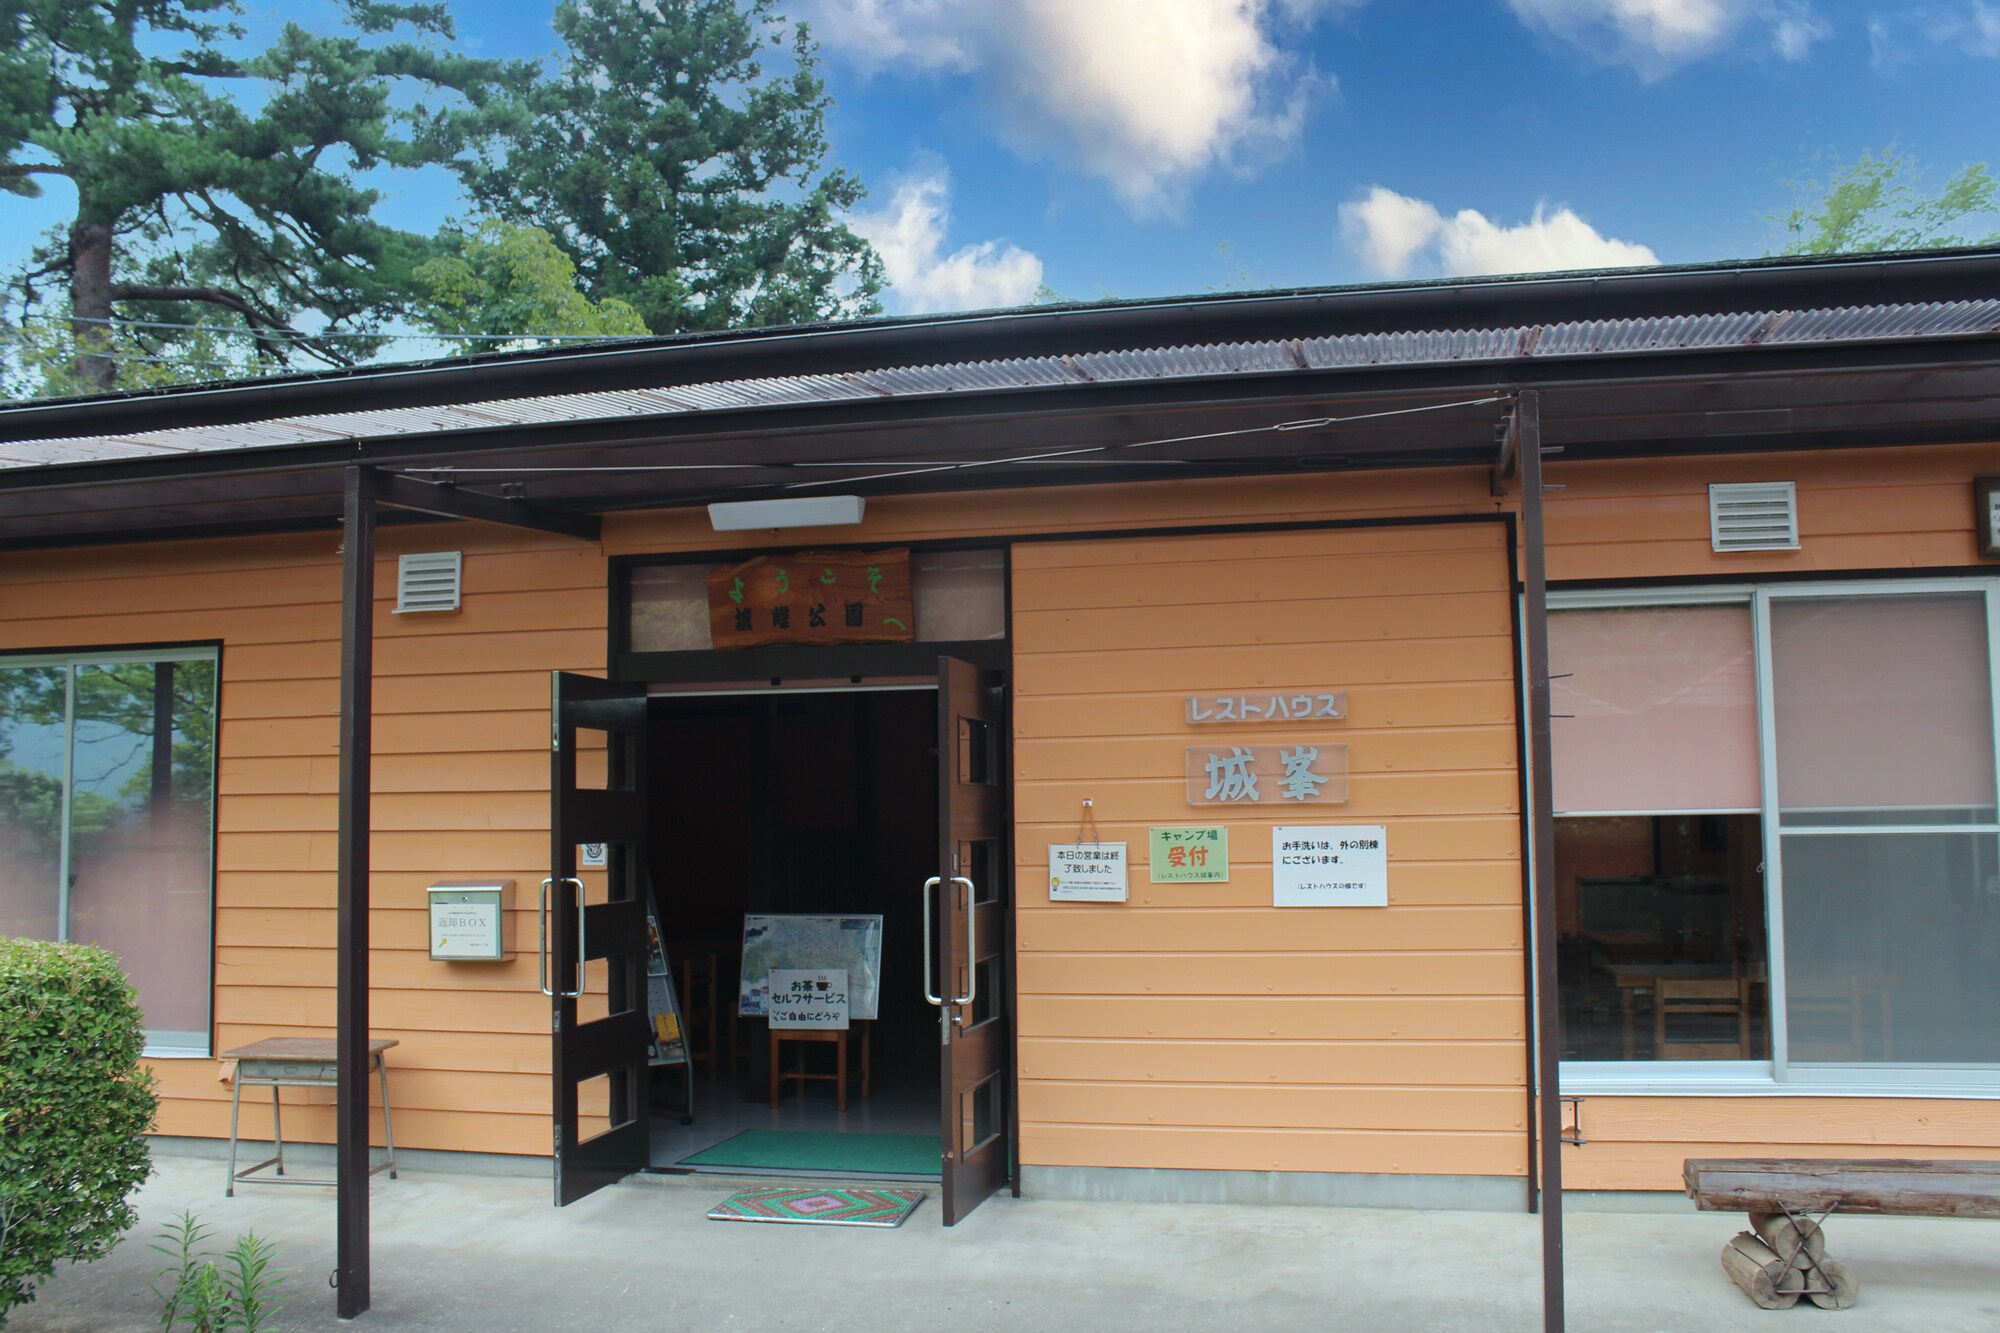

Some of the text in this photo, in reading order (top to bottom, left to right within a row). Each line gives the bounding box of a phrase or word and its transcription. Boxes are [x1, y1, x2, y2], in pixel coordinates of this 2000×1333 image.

[1192, 694, 1339, 721] レストハウス
[1161, 830, 1218, 841] キャンプ場
[1057, 850, 1119, 860] 本日の営業は終
[1168, 845, 1208, 868] 受付
[1064, 864, 1112, 874] 了致しました
[791, 979, 814, 992] お茶
[771, 992, 846, 1004] セルフサービス
[780, 1011, 841, 1021] ご自由にどうぞ
